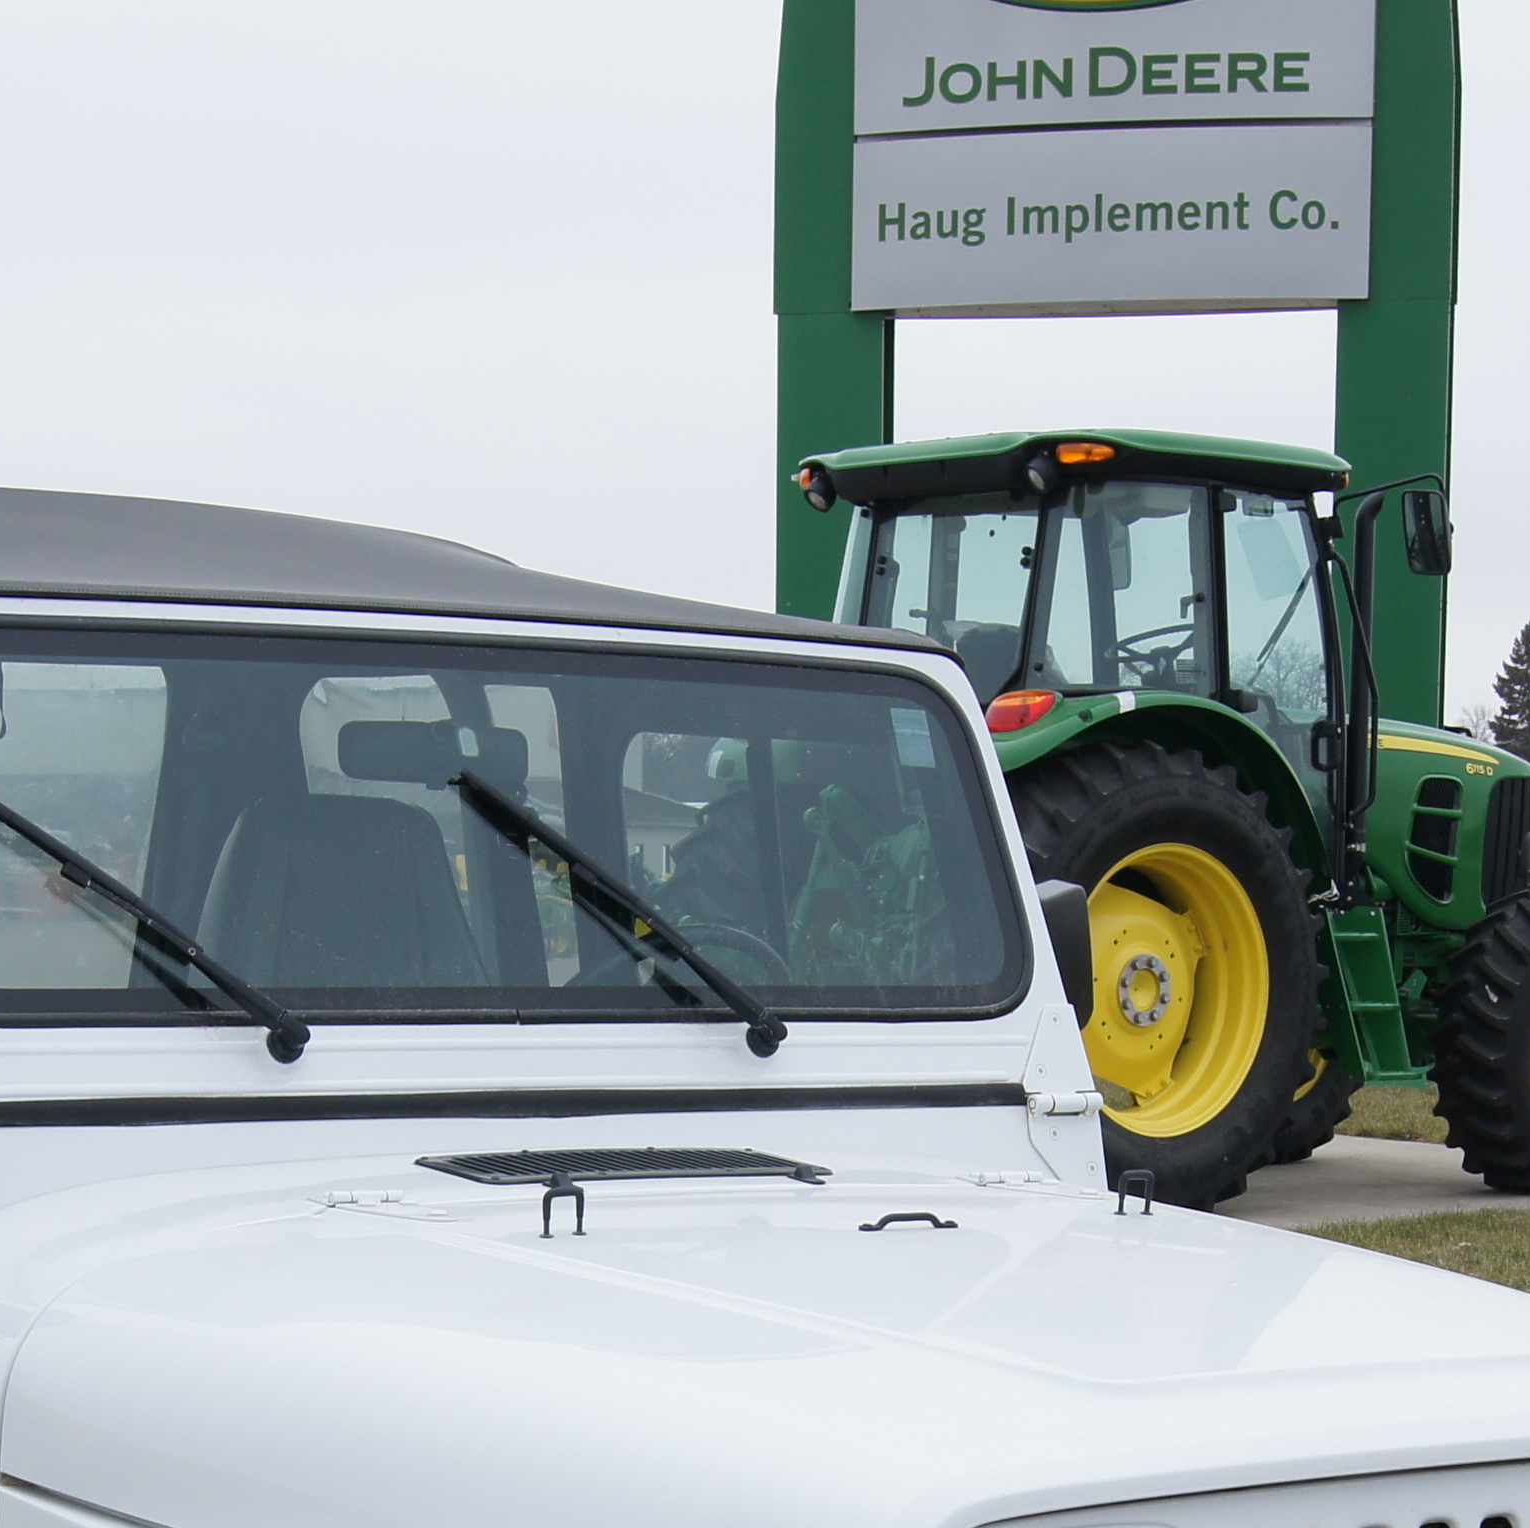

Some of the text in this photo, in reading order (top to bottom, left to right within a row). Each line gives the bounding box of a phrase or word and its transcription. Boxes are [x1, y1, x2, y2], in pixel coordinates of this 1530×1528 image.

[902, 46, 1311, 108] JOHN DEERE
[877, 189, 1341, 247] Haug Implement Co.
